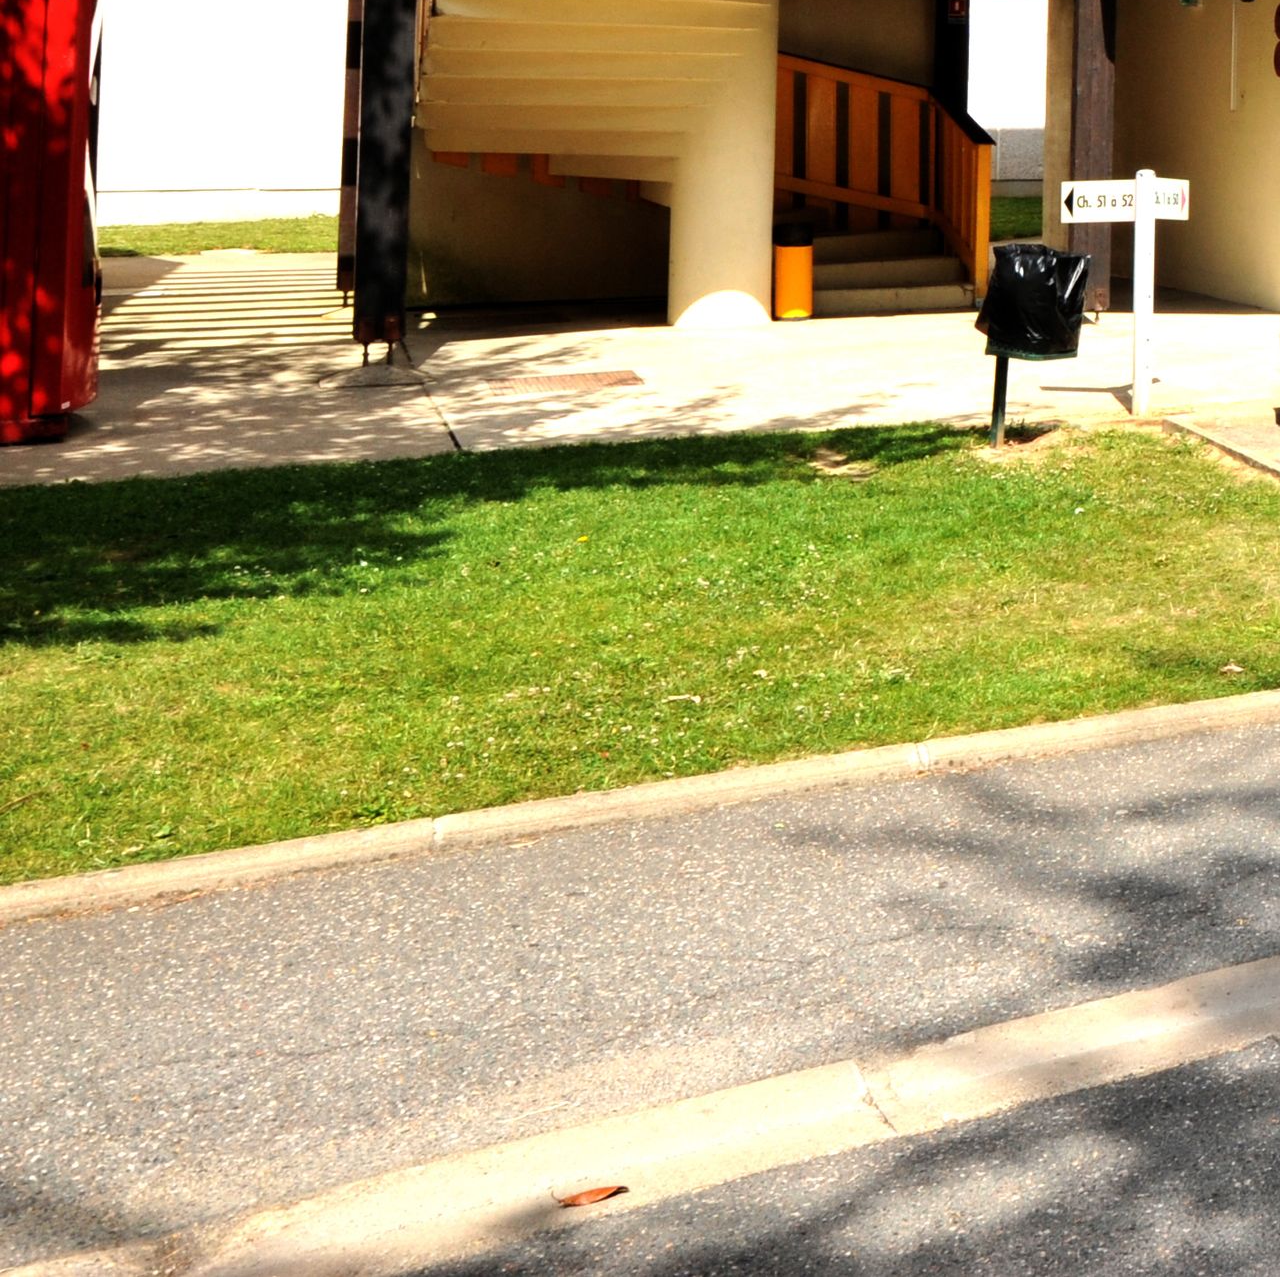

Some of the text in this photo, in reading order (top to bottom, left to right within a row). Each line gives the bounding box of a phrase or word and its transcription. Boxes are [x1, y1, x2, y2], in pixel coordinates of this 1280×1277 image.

[1076, 195, 1092, 208] Ch.
[1096, 195, 1107, 208] 51
[1121, 194, 1134, 207] 52
